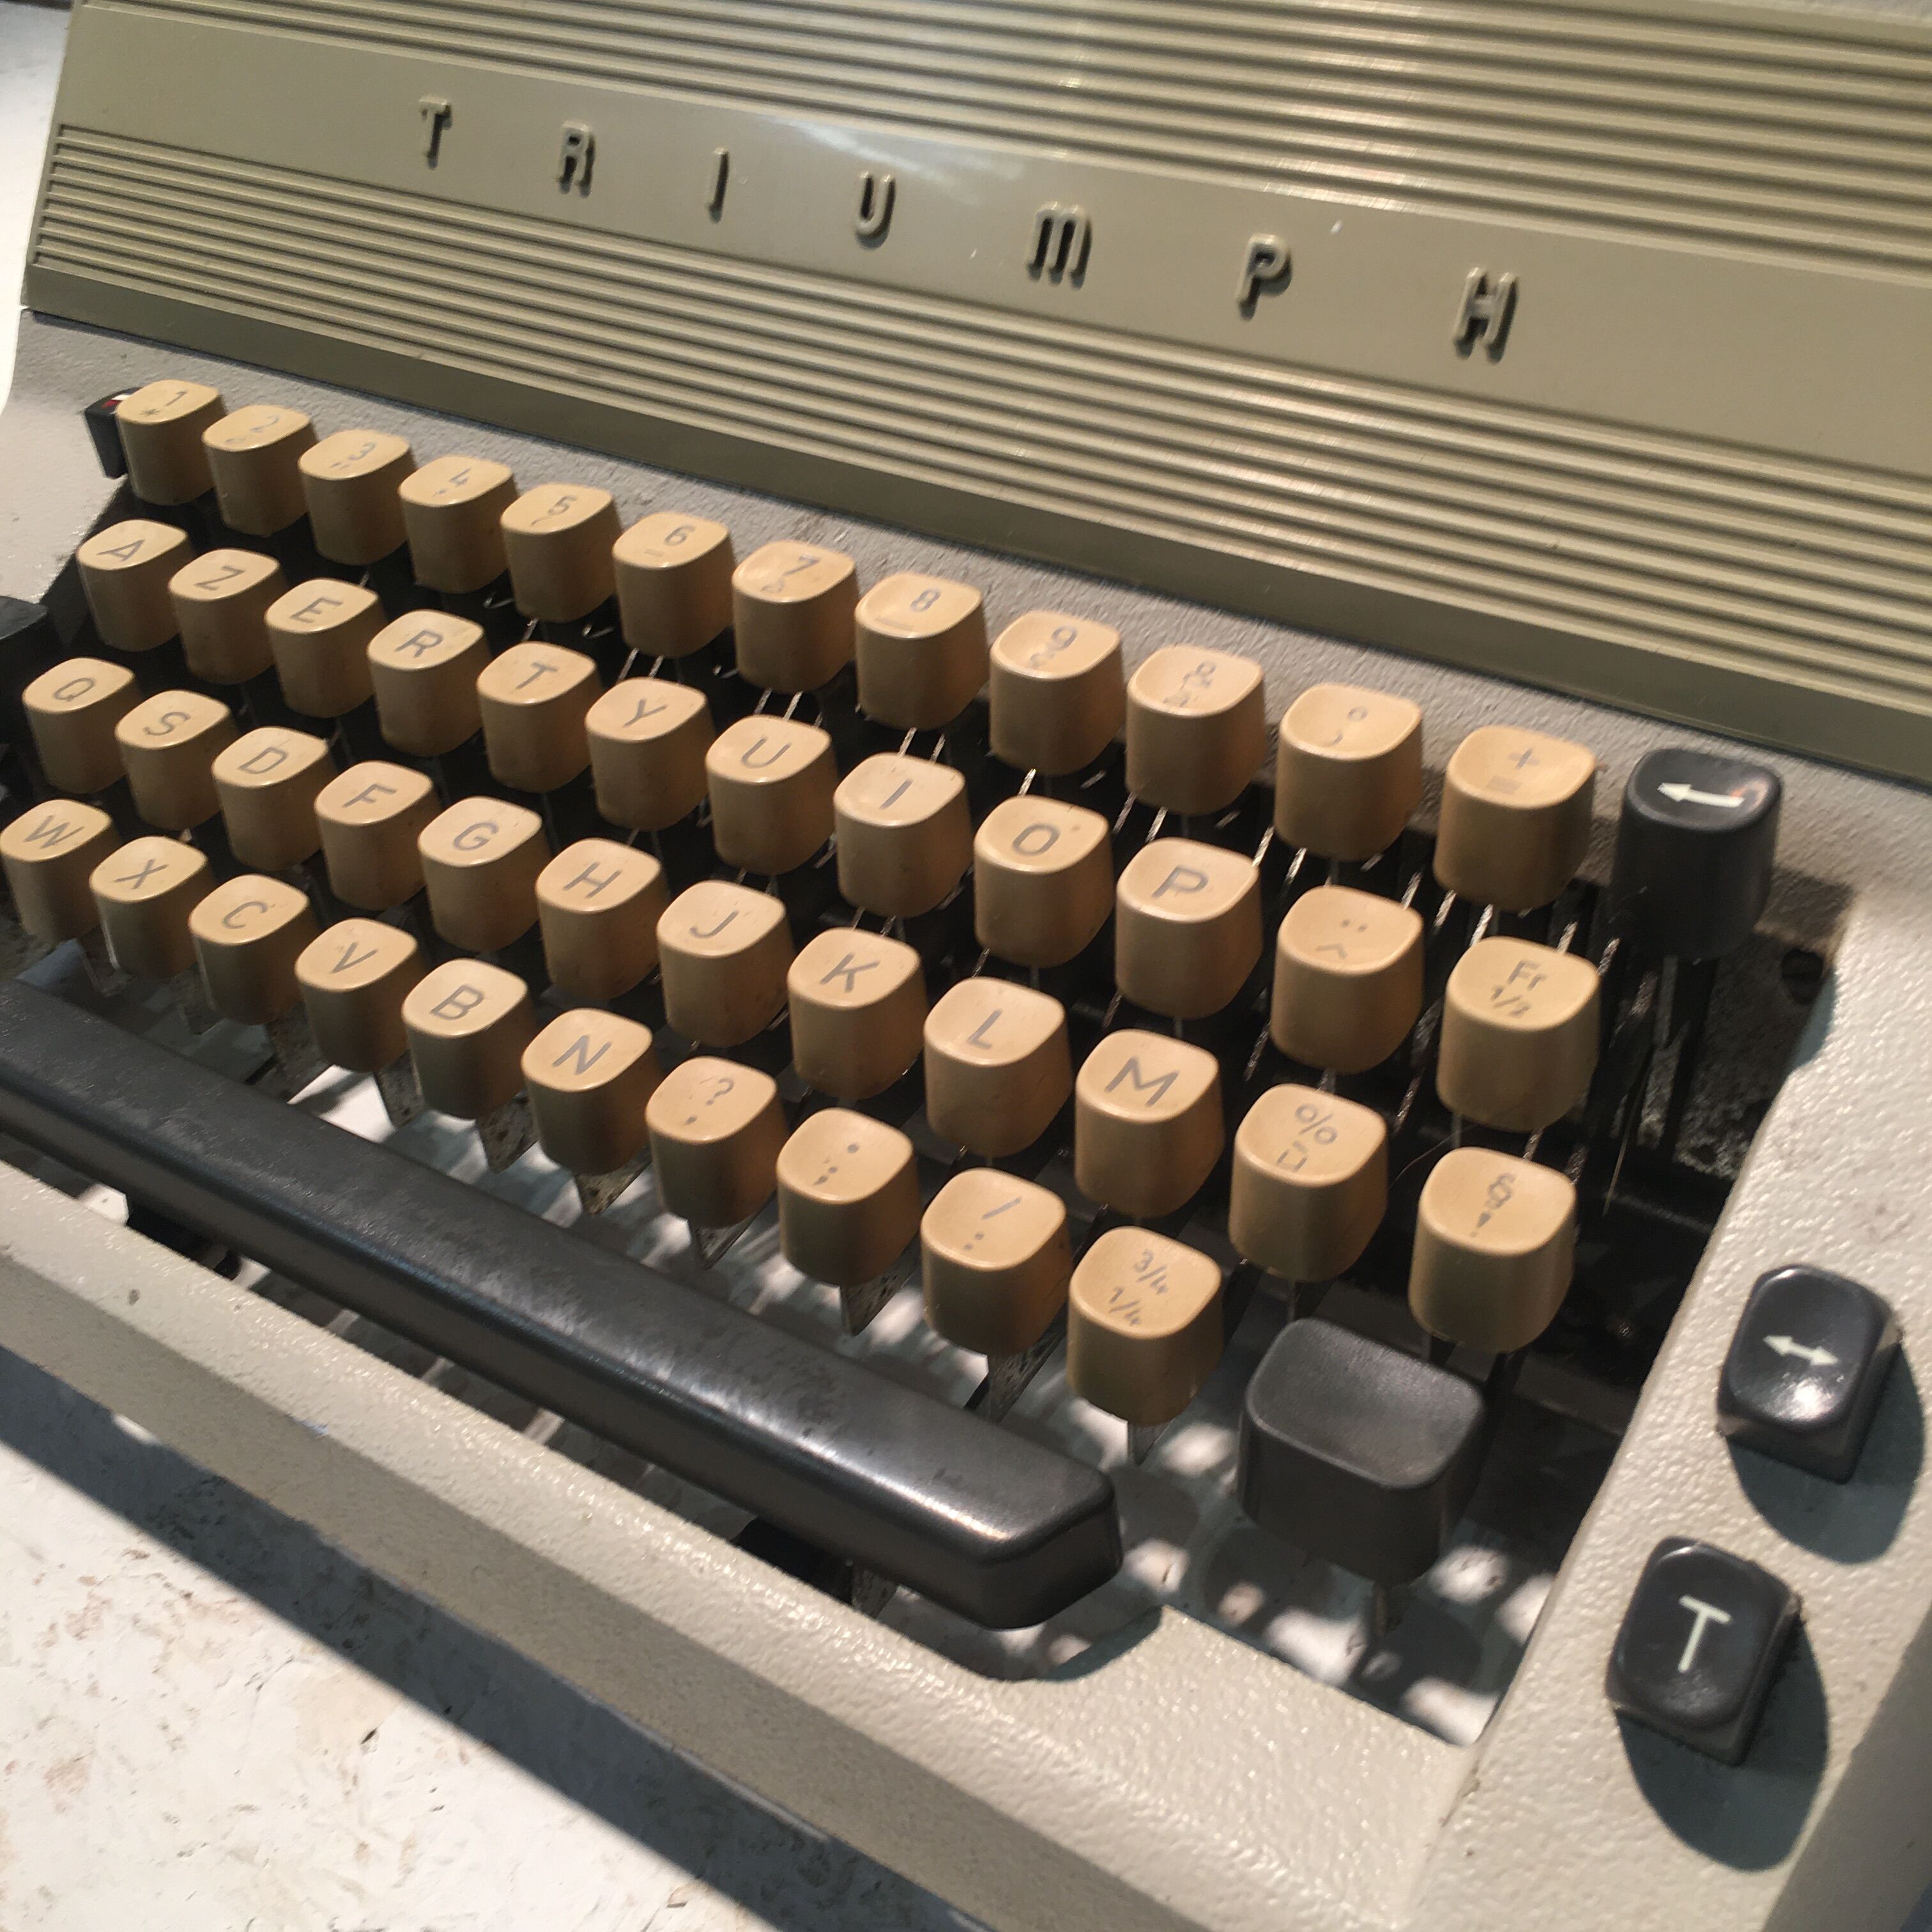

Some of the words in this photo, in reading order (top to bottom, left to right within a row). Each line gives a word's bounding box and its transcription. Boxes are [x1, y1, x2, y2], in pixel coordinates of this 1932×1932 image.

[448, 468, 473, 487] 4
[548, 494, 578, 516] 5
[96, 538, 146, 562] A
[663, 525, 696, 546] 6
[194, 564, 246, 592] Z
[783, 555, 822, 576] 7
[289, 596, 344, 624] E
[910, 587, 941, 613] 8
[394, 629, 444, 657] R
[1050, 625, 1078, 652] 9
[52, 677, 96, 702] Q
[515, 661, 559, 691] T
[142, 711, 190, 736] S
[622, 698, 668, 728] Y
[237, 746, 289, 774] D
[740, 735, 792, 768] U
[342, 783, 397, 808] F
[23, 815, 86, 849] W
[453, 822, 499, 851] G
[1011, 823, 1060, 857] O
[114, 859, 169, 890] X
[562, 861, 622, 899] H
[1151, 864, 1209, 900] P
[222, 901, 268, 930] C
[689, 910, 740, 939] J
[329, 942, 379, 974] V
[819, 953, 879, 993] K
[429, 984, 485, 1021] B
[967, 1009, 1002, 1050] L
[551, 1034, 612, 1076] N
[705, 1077, 735, 1107] ?
[1105, 1056, 1179, 1107] M
[1678, 1595, 1732, 1673] T
